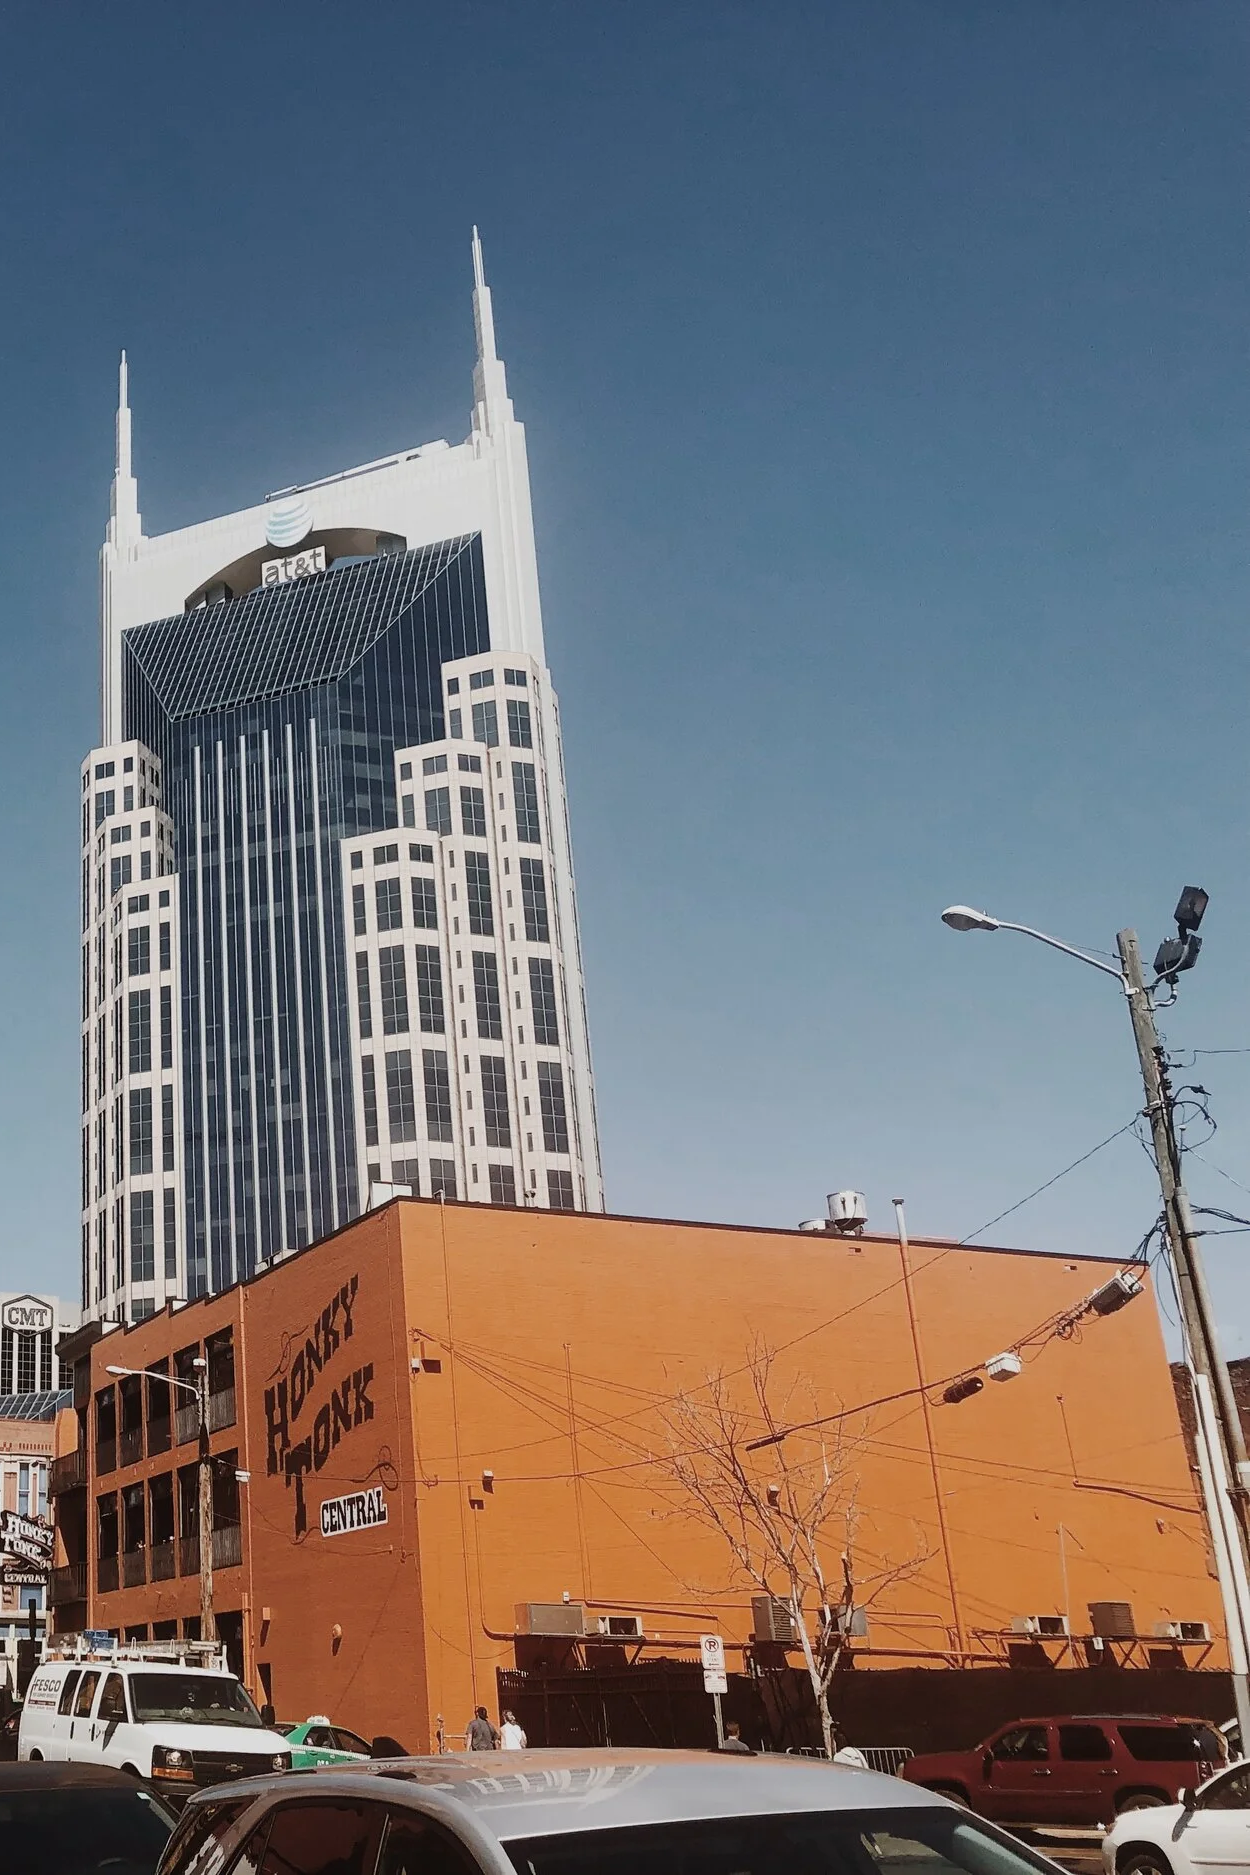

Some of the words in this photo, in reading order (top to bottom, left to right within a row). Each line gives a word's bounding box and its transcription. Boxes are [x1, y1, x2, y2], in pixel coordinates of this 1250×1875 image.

[264, 549, 322, 586] at&t
[8, 1306, 48, 1327] CMT
[264, 1273, 359, 1478] HONKY
[284, 1362, 375, 1540] TONK
[7, 1513, 54, 1546] HONKY
[321, 1489, 387, 1535] CENTRAL
